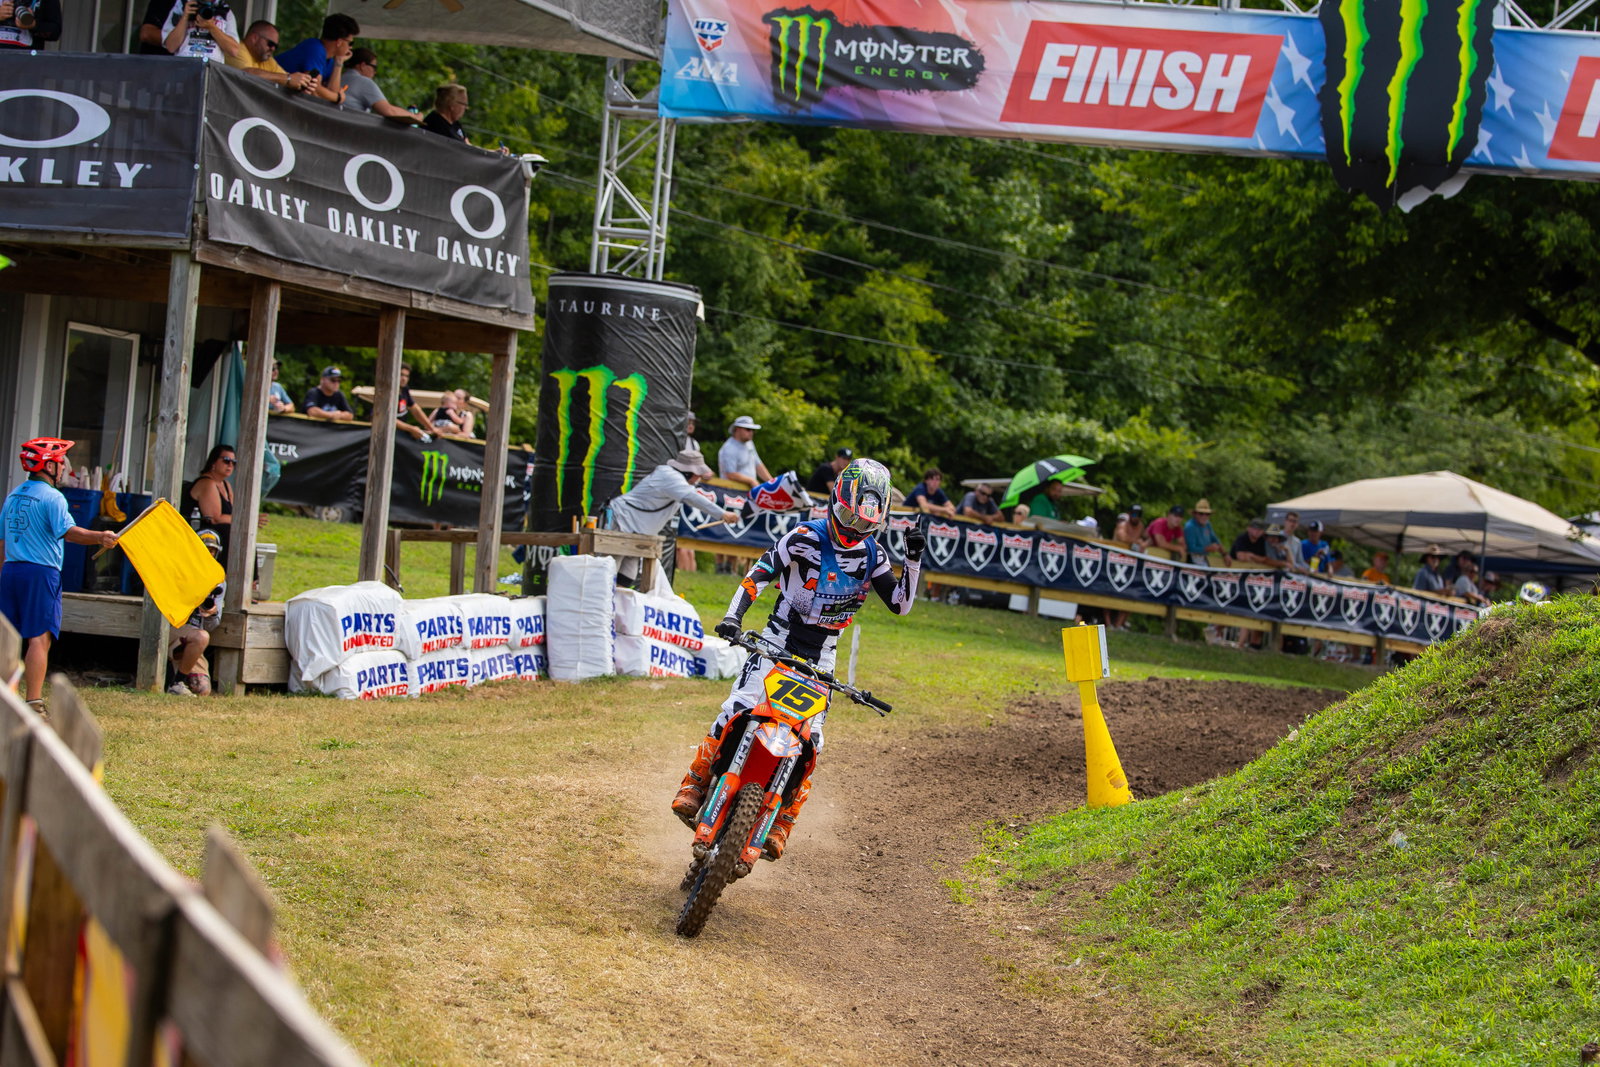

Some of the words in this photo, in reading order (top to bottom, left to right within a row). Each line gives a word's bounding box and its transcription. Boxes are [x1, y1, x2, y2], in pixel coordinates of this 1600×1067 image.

[854, 65, 949, 81] ENERGY
[1029, 42, 1252, 113] FINISH
[210, 172, 307, 223] OAKLEY
[328, 207, 419, 252] OAKLEY
[437, 236, 519, 277] OAKLEY
[559, 299, 661, 321] TAURINE
[341, 612, 395, 637] PARTS
[416, 615, 463, 640] PARTS
[468, 616, 511, 637] PARTS
[644, 605, 704, 639] PARTS
[642, 626, 703, 651] UNLIMITED
[417, 658, 469, 685] PARTS
[471, 653, 515, 683] PARTS
[514, 654, 547, 675] PAR
[651, 645, 696, 677] PARTS
[357, 662, 408, 692] PARTS
[770, 679, 823, 713] 15
